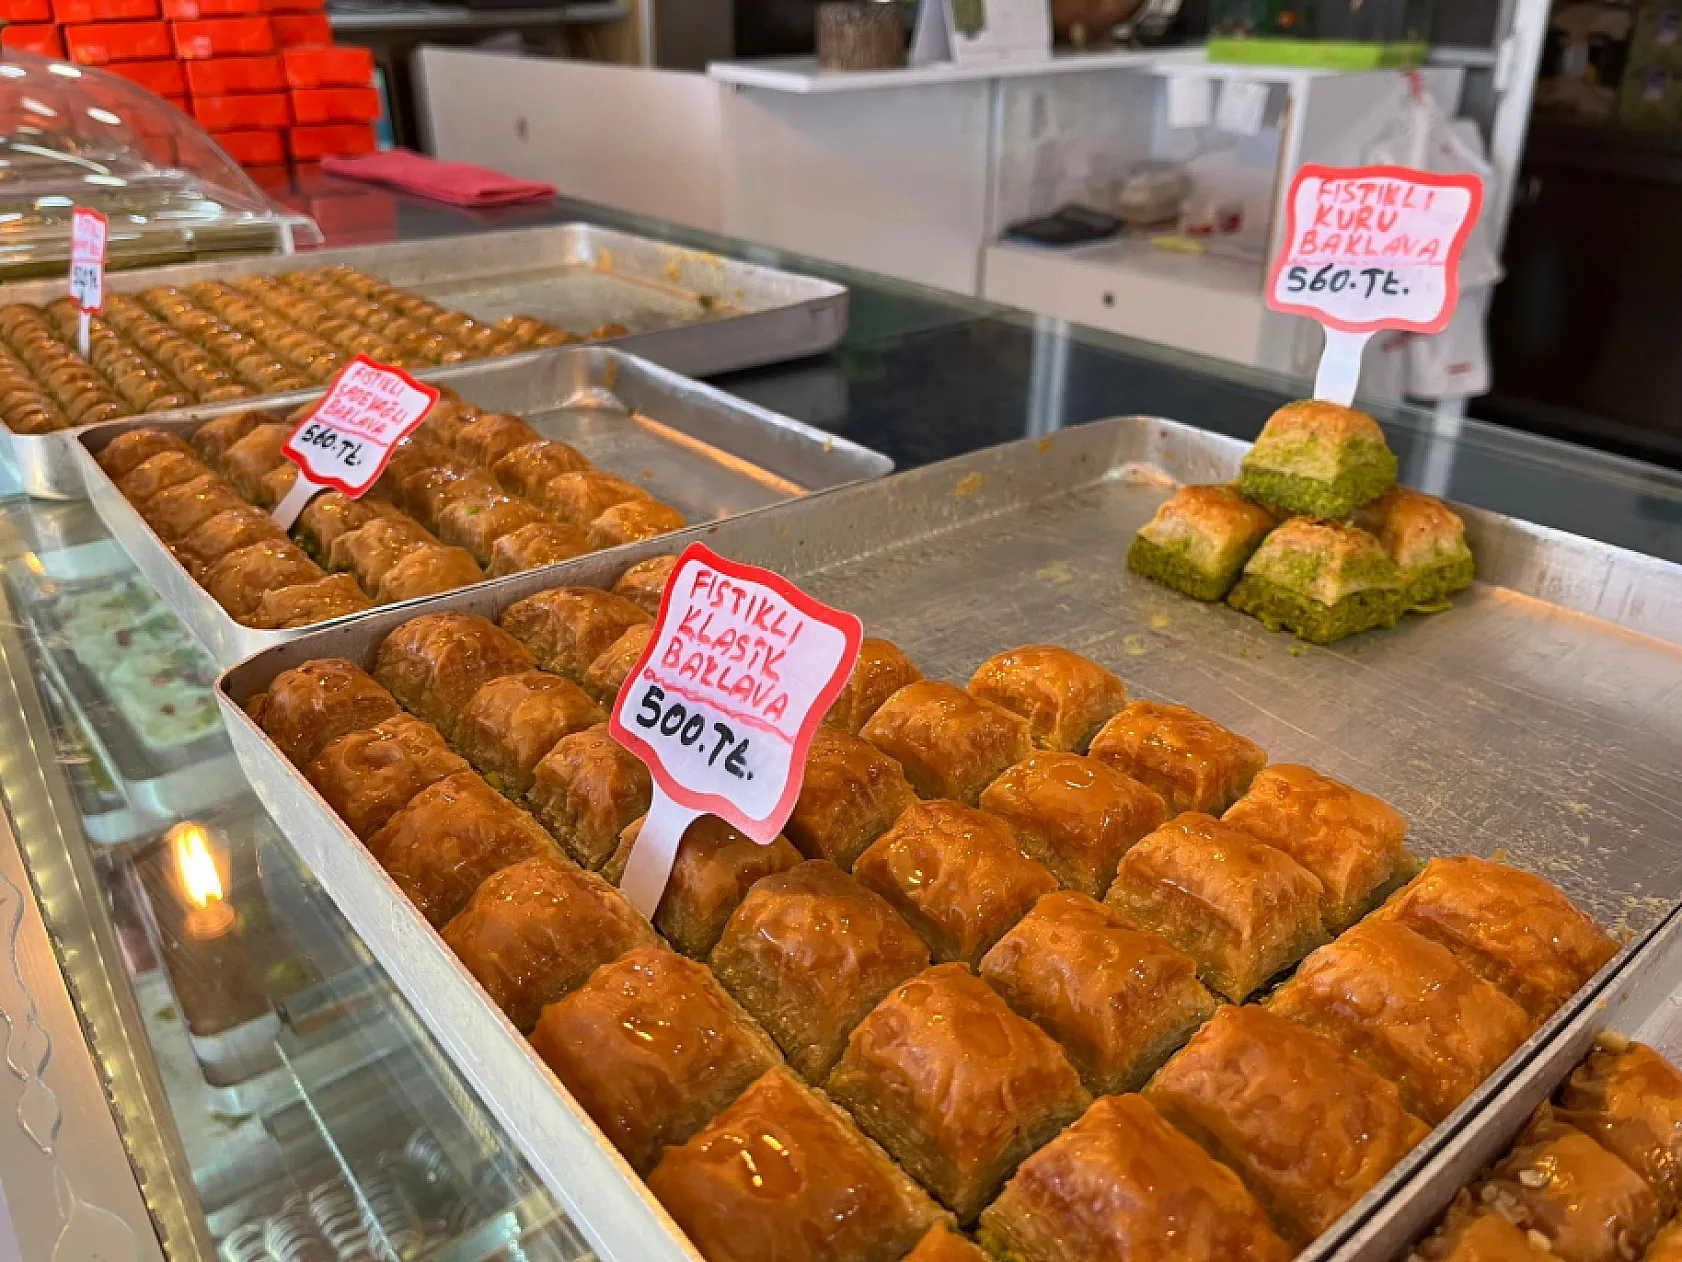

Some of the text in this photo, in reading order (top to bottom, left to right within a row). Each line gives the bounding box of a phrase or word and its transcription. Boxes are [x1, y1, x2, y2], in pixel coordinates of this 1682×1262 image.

[1316, 178, 1435, 211] FISTIKLI
[1314, 205, 1400, 233] KURU
[1298, 229, 1440, 258] BAKLAVA
[689, 570, 804, 645] FISTIKLI
[661, 637, 790, 722] BAKLAVA
